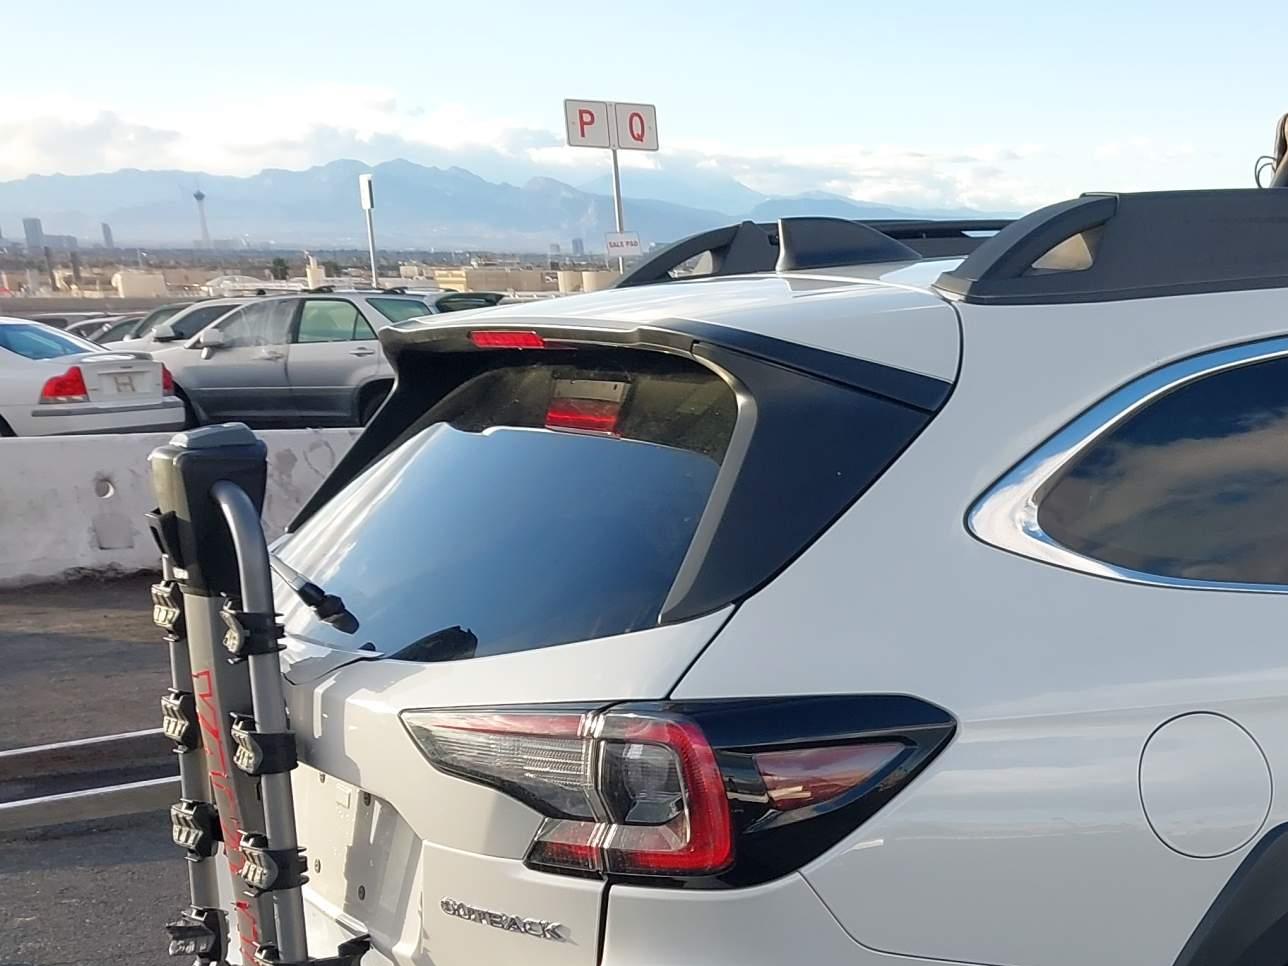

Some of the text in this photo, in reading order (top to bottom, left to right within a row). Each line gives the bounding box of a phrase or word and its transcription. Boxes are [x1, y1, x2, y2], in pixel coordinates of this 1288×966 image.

[578, 109, 595, 138] P
[628, 112, 645, 143] Q
[440, 896, 566, 943] OUTBACK
